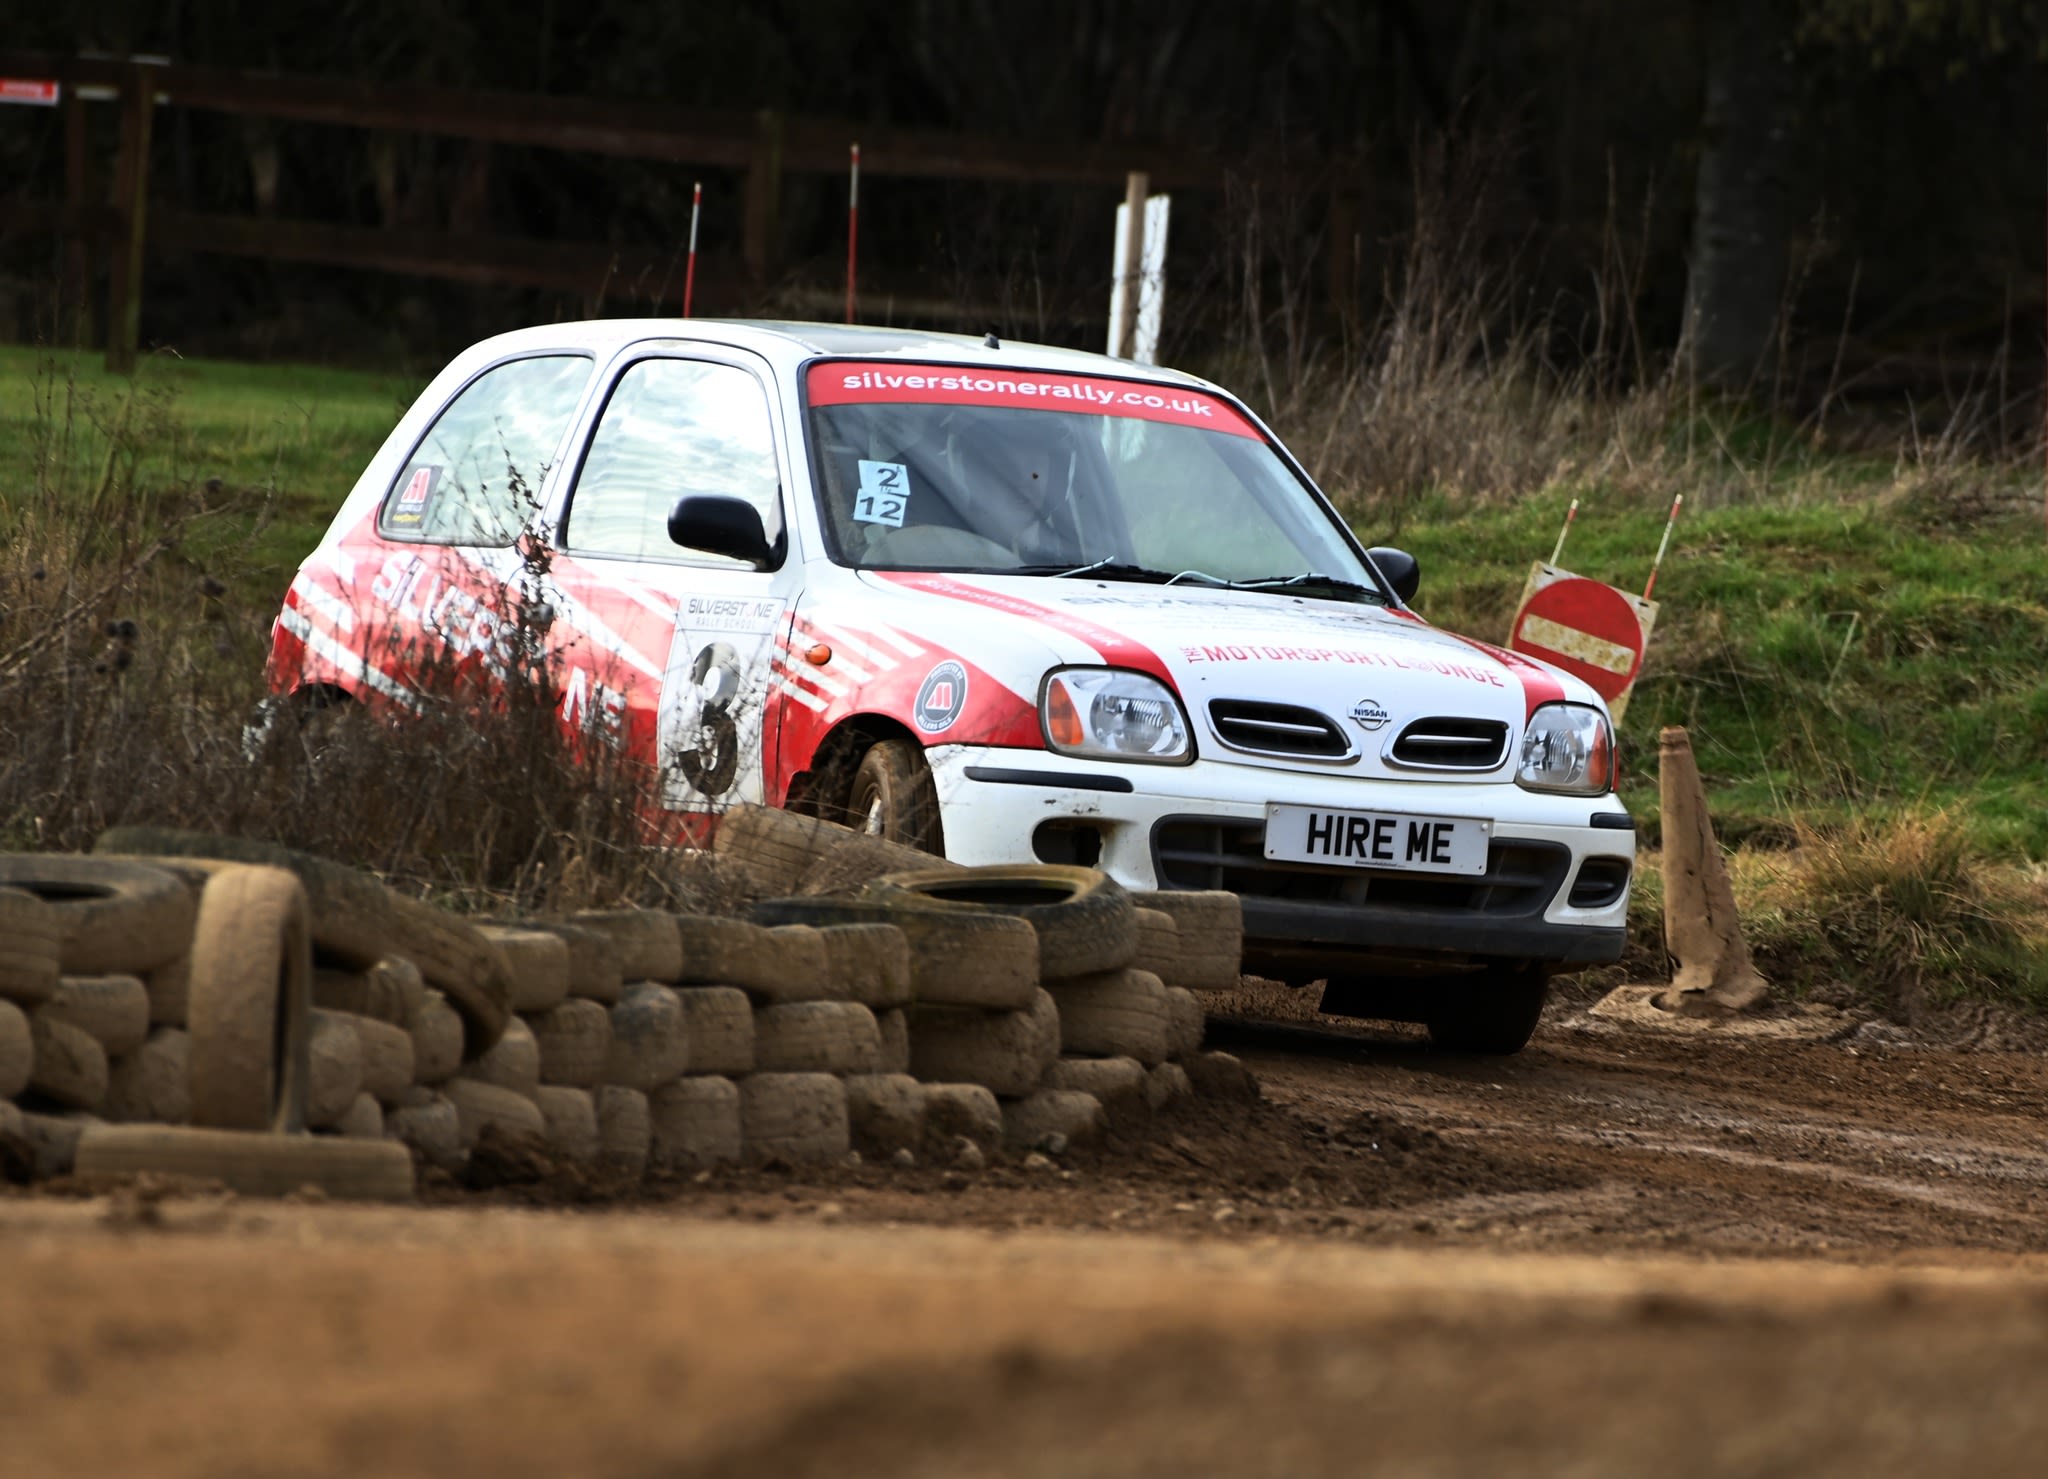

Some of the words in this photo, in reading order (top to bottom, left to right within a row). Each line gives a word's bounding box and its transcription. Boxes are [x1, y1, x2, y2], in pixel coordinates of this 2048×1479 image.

[843, 372, 1213, 417] silverstonerally.co.uk
[877, 468, 900, 488] 2
[860, 497, 901, 520] 12
[677, 642, 740, 796] 3
[1354, 708, 1387, 718] NISSAN
[1306, 813, 1397, 860] HIRE
[1405, 821, 1455, 864] ME
